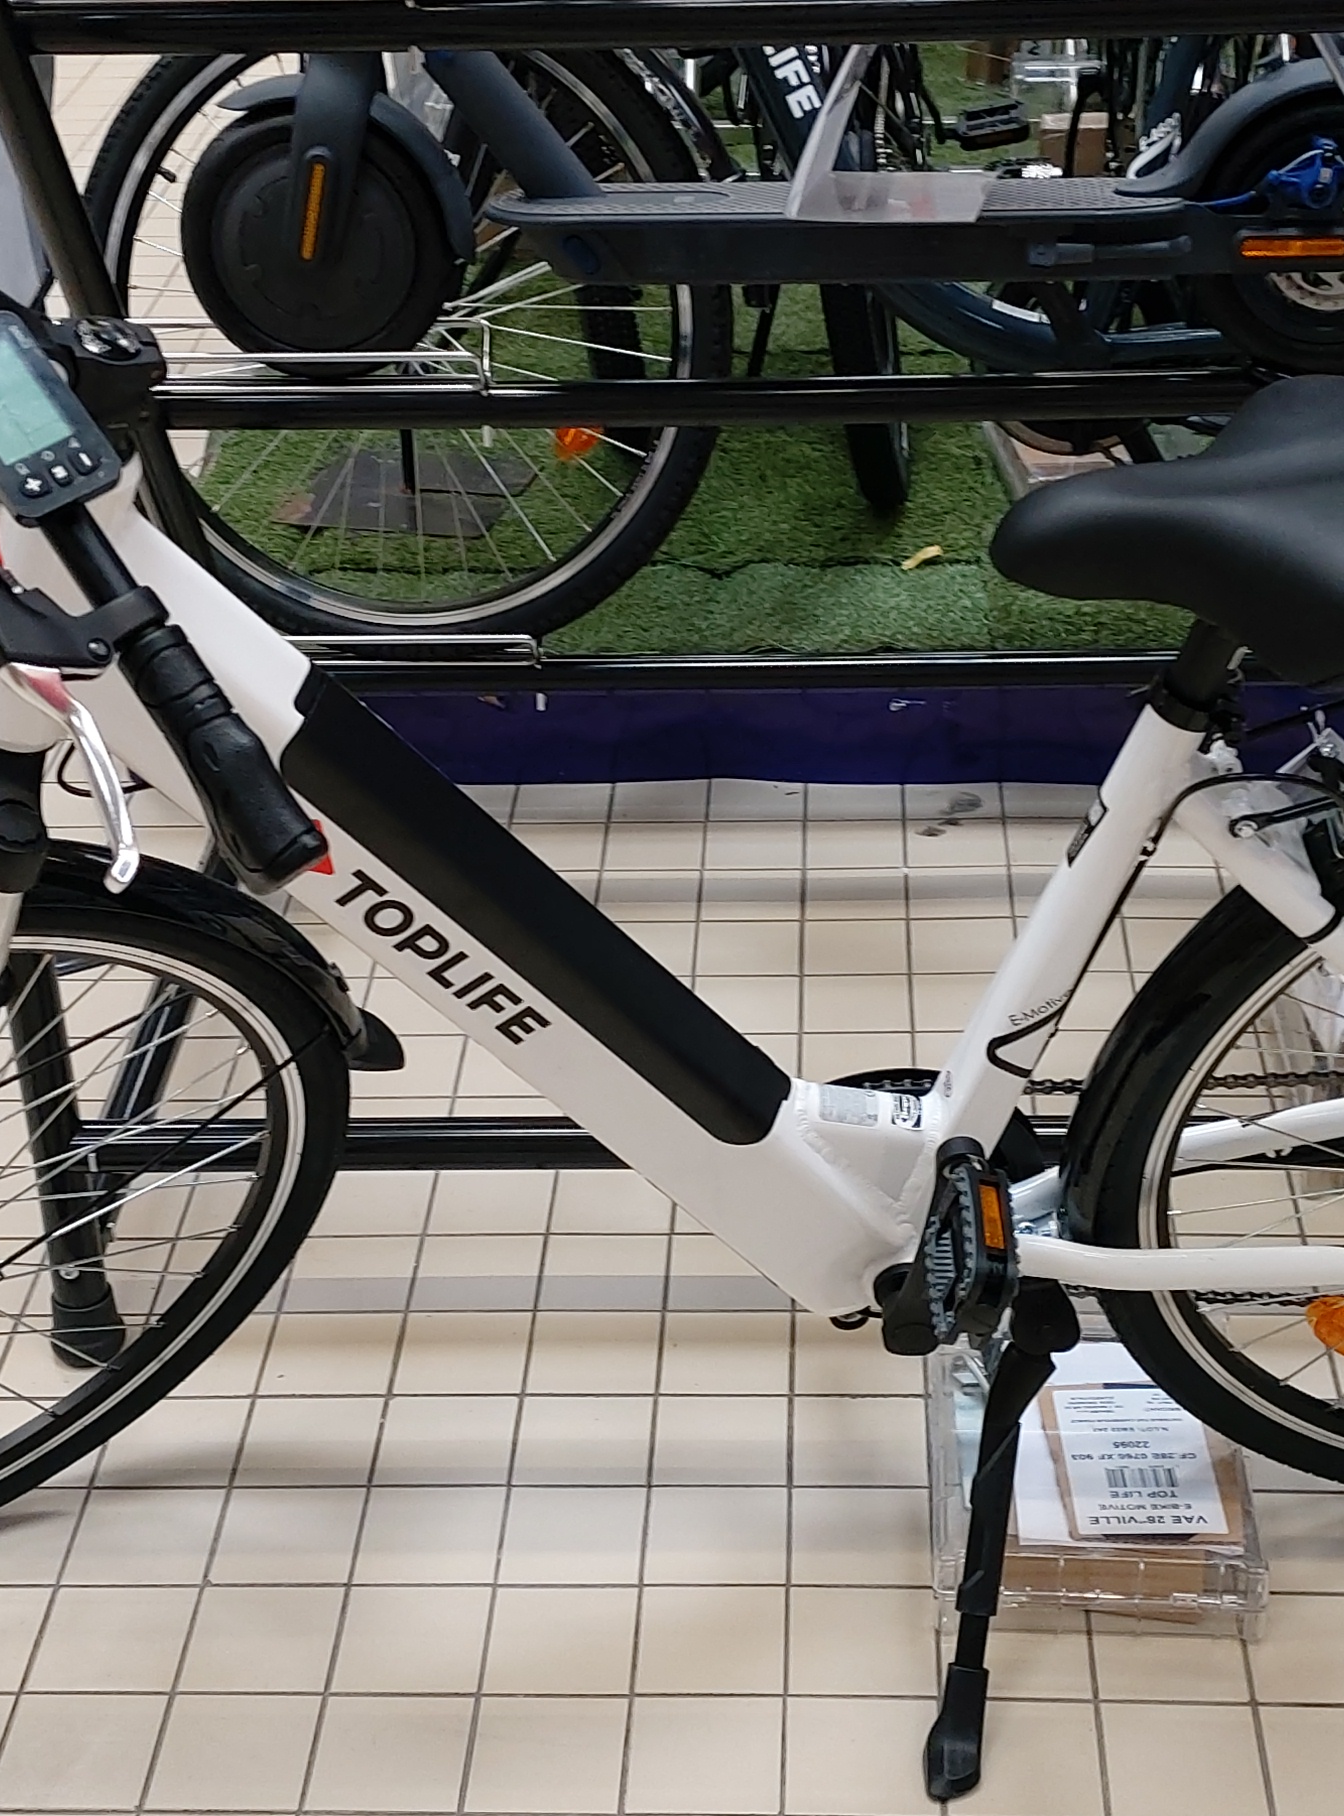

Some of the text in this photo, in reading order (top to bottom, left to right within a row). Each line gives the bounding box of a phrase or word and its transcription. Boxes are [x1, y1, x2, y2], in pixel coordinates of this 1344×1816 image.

[762, 45, 822, 119] IFE
[335, 869, 552, 1045] TOPLIFE
[1110, 1490, 1178, 1499] TOP LIFE
[1171, 1515, 1208, 1524] VAE
